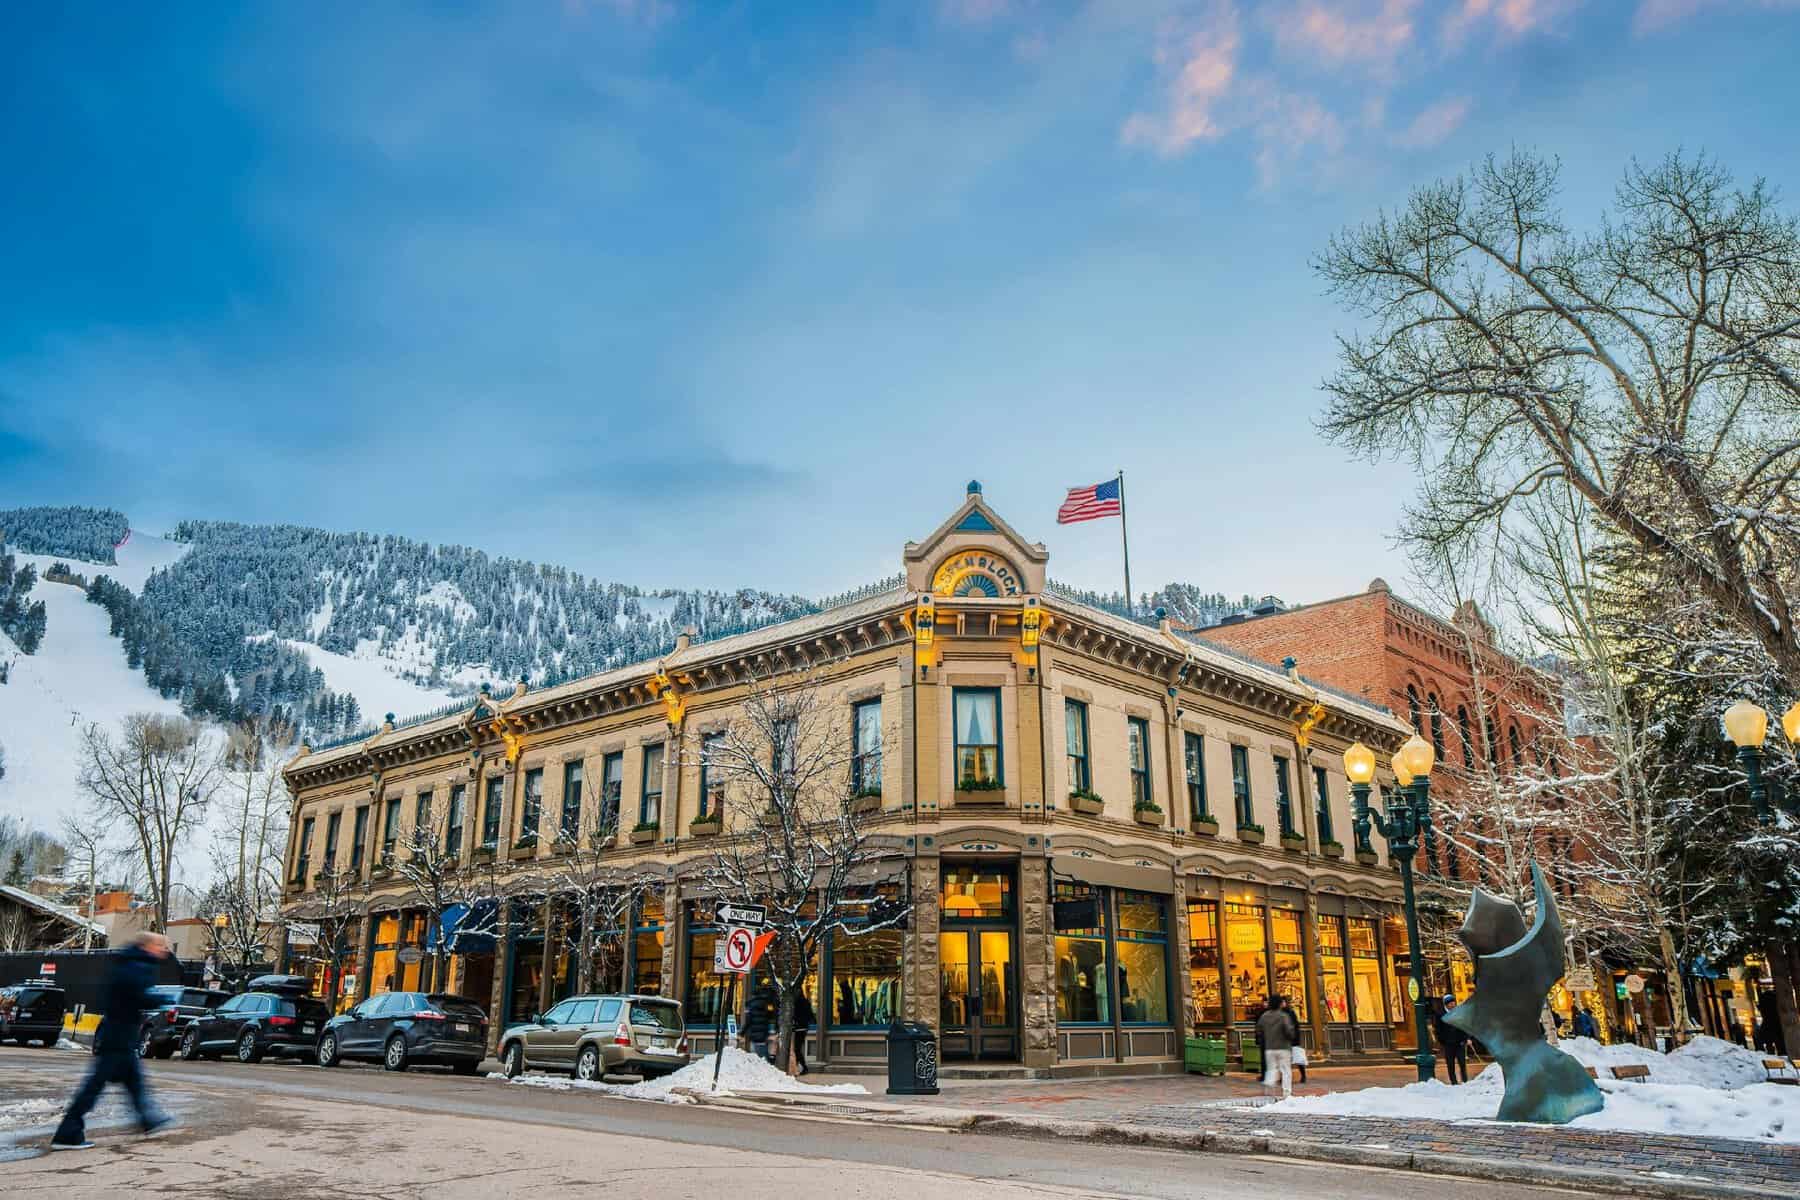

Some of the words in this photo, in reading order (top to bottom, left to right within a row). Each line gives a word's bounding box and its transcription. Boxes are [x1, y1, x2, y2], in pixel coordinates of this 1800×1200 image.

[979, 557, 1018, 595] BLOCK
[730, 910, 745, 919] ONE
[745, 912, 761, 921] WAY
